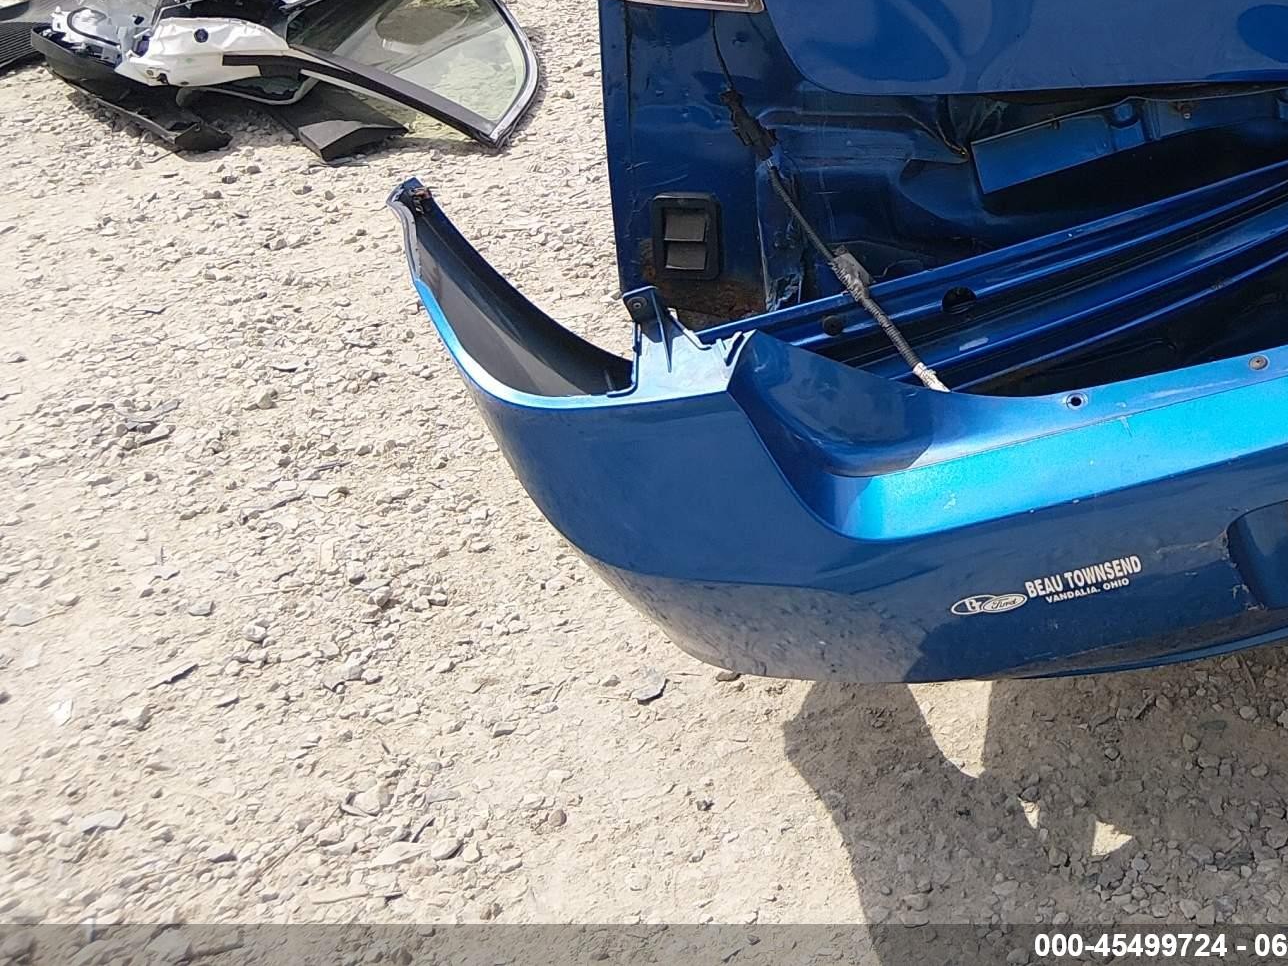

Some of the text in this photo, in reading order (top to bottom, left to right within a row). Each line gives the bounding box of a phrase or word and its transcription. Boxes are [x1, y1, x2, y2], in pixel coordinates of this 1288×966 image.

[1025, 555, 1142, 598] BEAU TOWNSEND
[1103, 578, 1130, 591] OHIO
